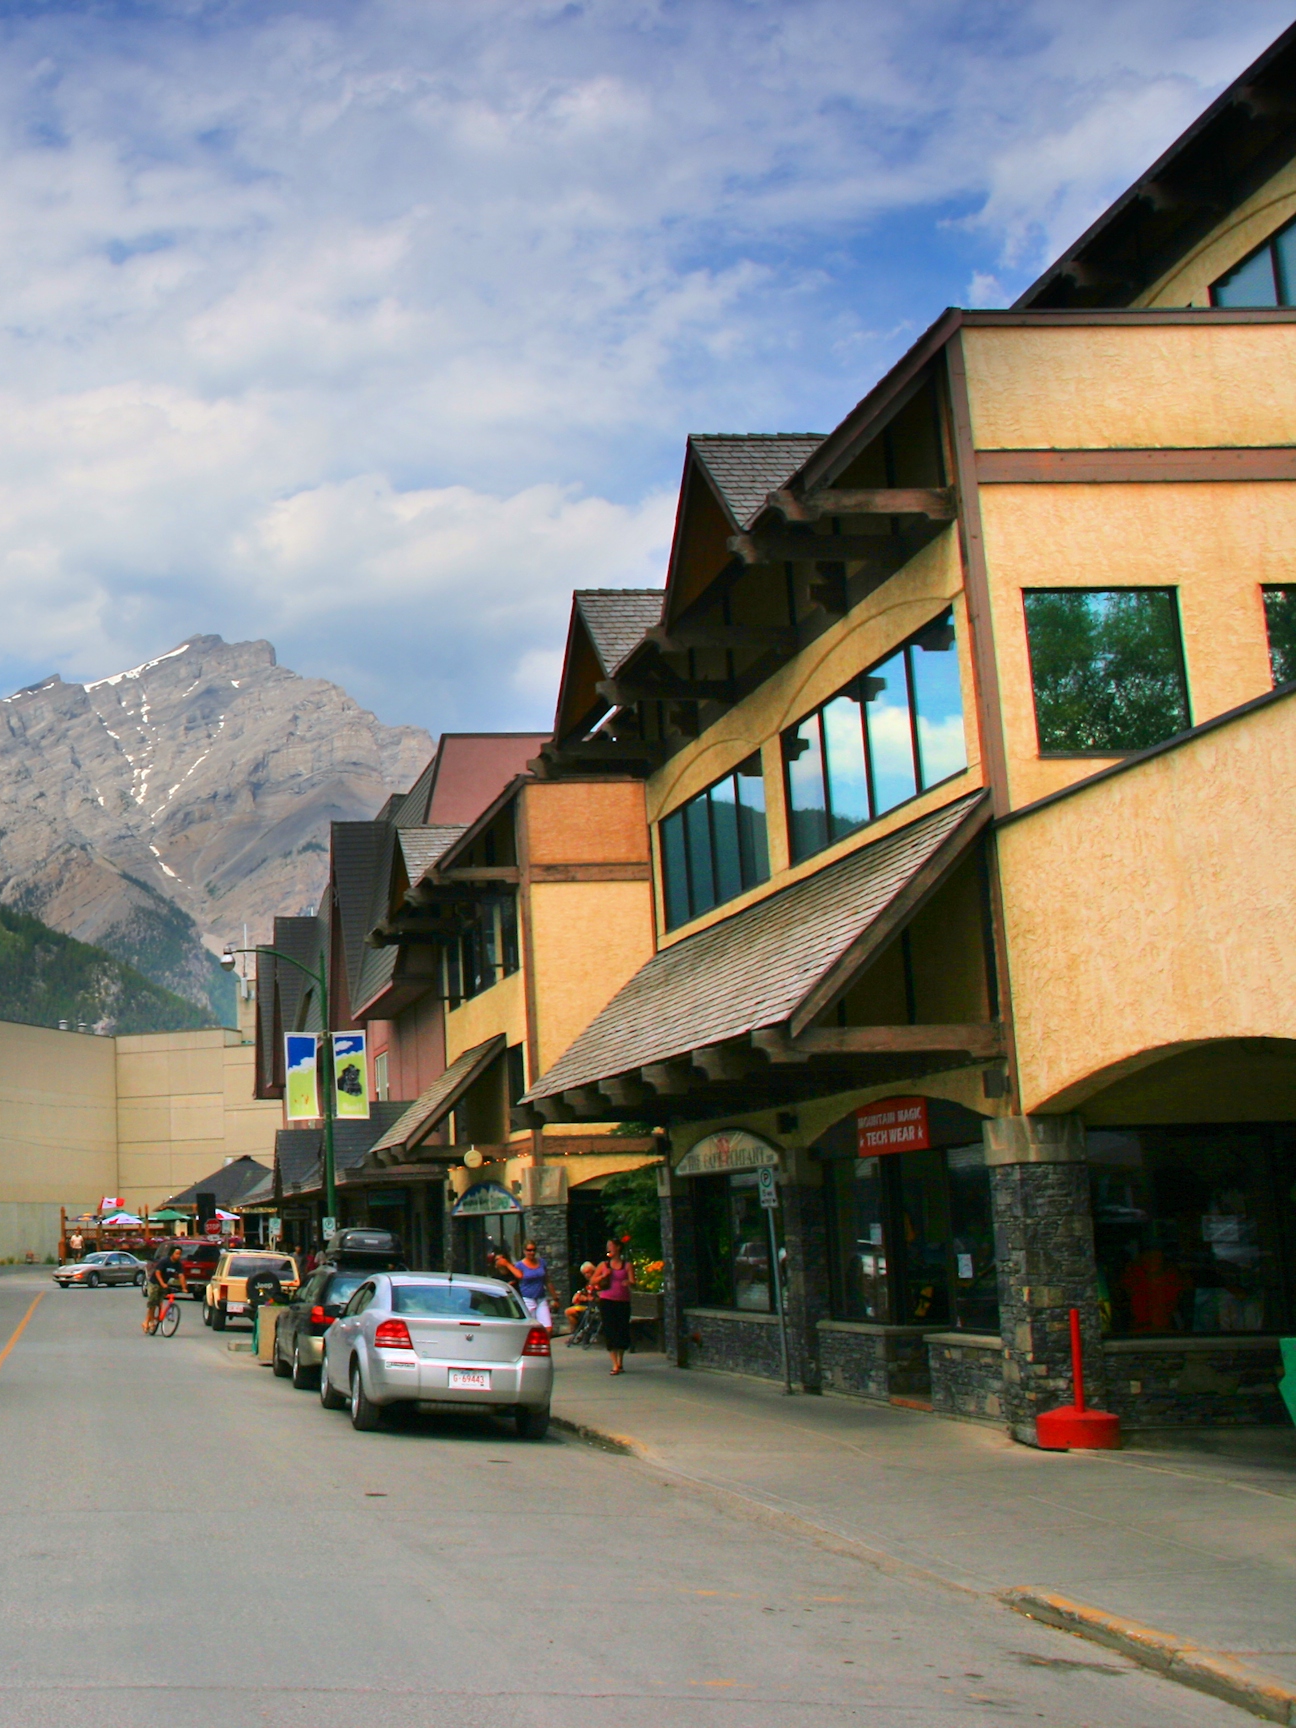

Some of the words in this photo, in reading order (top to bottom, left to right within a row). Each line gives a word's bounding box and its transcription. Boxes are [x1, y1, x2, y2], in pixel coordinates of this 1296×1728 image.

[858, 1114, 896, 1129] MOUNTAIN
[897, 1106, 922, 1122] MAGIC
[865, 1130, 888, 1146] TECH
[889, 1125, 915, 1143] WEAR
[205, 1223, 220, 1231] STOP
